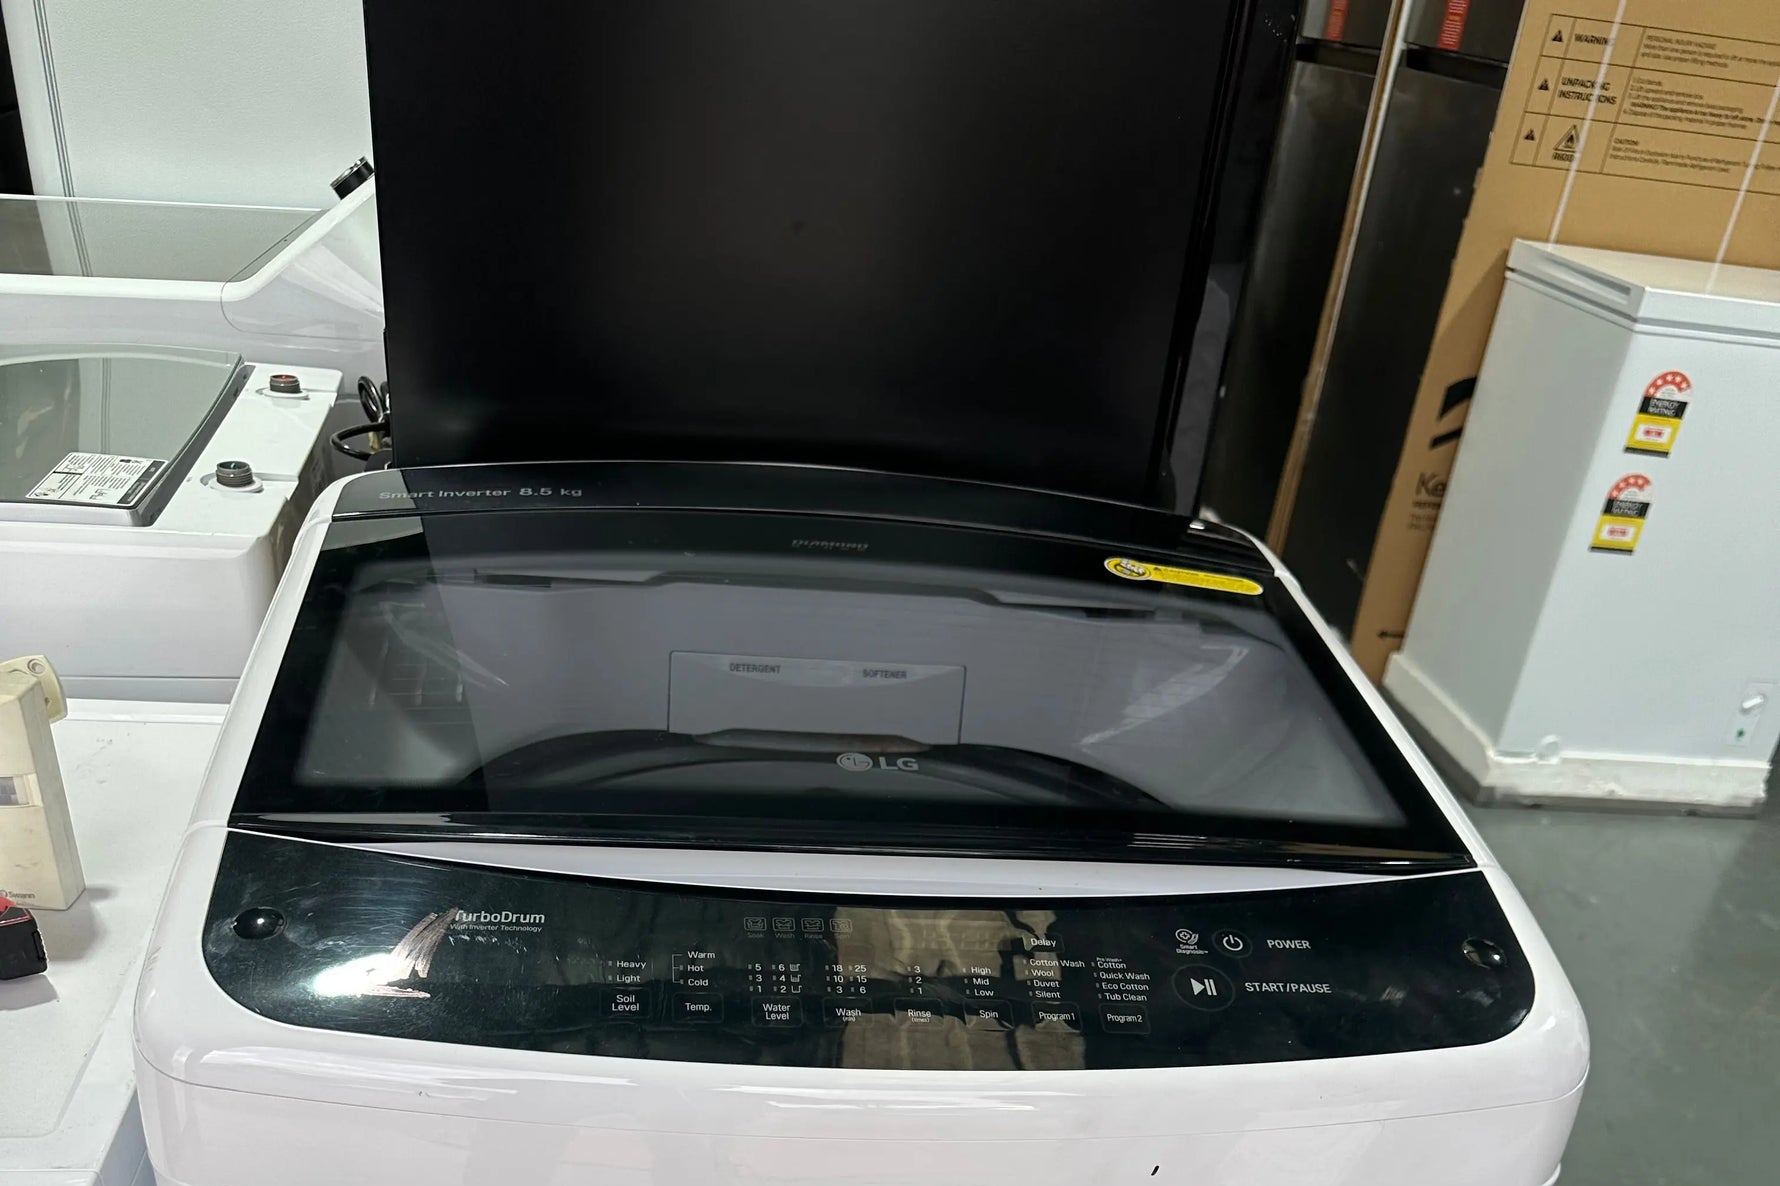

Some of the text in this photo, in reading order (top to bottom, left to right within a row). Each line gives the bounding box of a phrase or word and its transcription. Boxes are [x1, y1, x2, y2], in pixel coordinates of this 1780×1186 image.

[379, 487, 583, 499] Smart Inverter 8.5 kg
[729, 662, 781, 674] DETERGENT
[862, 669, 907, 679] SOFTENER
[879, 757, 919, 771] LG
[455, 909, 545, 923] TurboDrum
[500, 925, 543, 933] Technology
[1030, 938, 1057, 948] Delay
[1266, 939, 1311, 950] POWER
[687, 951, 715, 959] Warm
[616, 960, 646, 970] Heavy
[687, 964, 704, 972] Hot
[755, 963, 785, 971] 5 6
[832, 964, 867, 972] 18 25
[1029, 959, 1085, 968] Cotton Wash
[1097, 961, 1127, 969] Cotton
[971, 966, 991, 975] High
[1031, 969, 1054, 977] Wool
[616, 973, 641, 983] Light
[755, 974, 786, 982] 3 4
[833, 975, 867, 983] 10 15
[915, 976, 922, 984] 2
[1099, 971, 1150, 981] Quick Wash
[688, 978, 708, 986] Cold
[973, 978, 989, 986] Mid
[1033, 980, 1060, 988] Duvet
[1102, 982, 1149, 991] Eco Cotton
[780, 985, 787, 993] 2
[836, 986, 866, 994] 3 6
[1244, 982, 1332, 994] START/PAUSE
[616, 994, 635, 1003] Soil
[1035, 990, 1061, 999] Silent
[1104, 992, 1147, 1001] Tub Clean
[612, 1002, 640, 1012] Level
[685, 1003, 712, 1013] Temp.
[763, 1003, 791, 1011] Water
[766, 1011, 790, 1020] Level
[835, 1008, 861, 1016] Wash
[908, 1009, 931, 1018] Rinse
[979, 1010, 998, 1018] Spin
